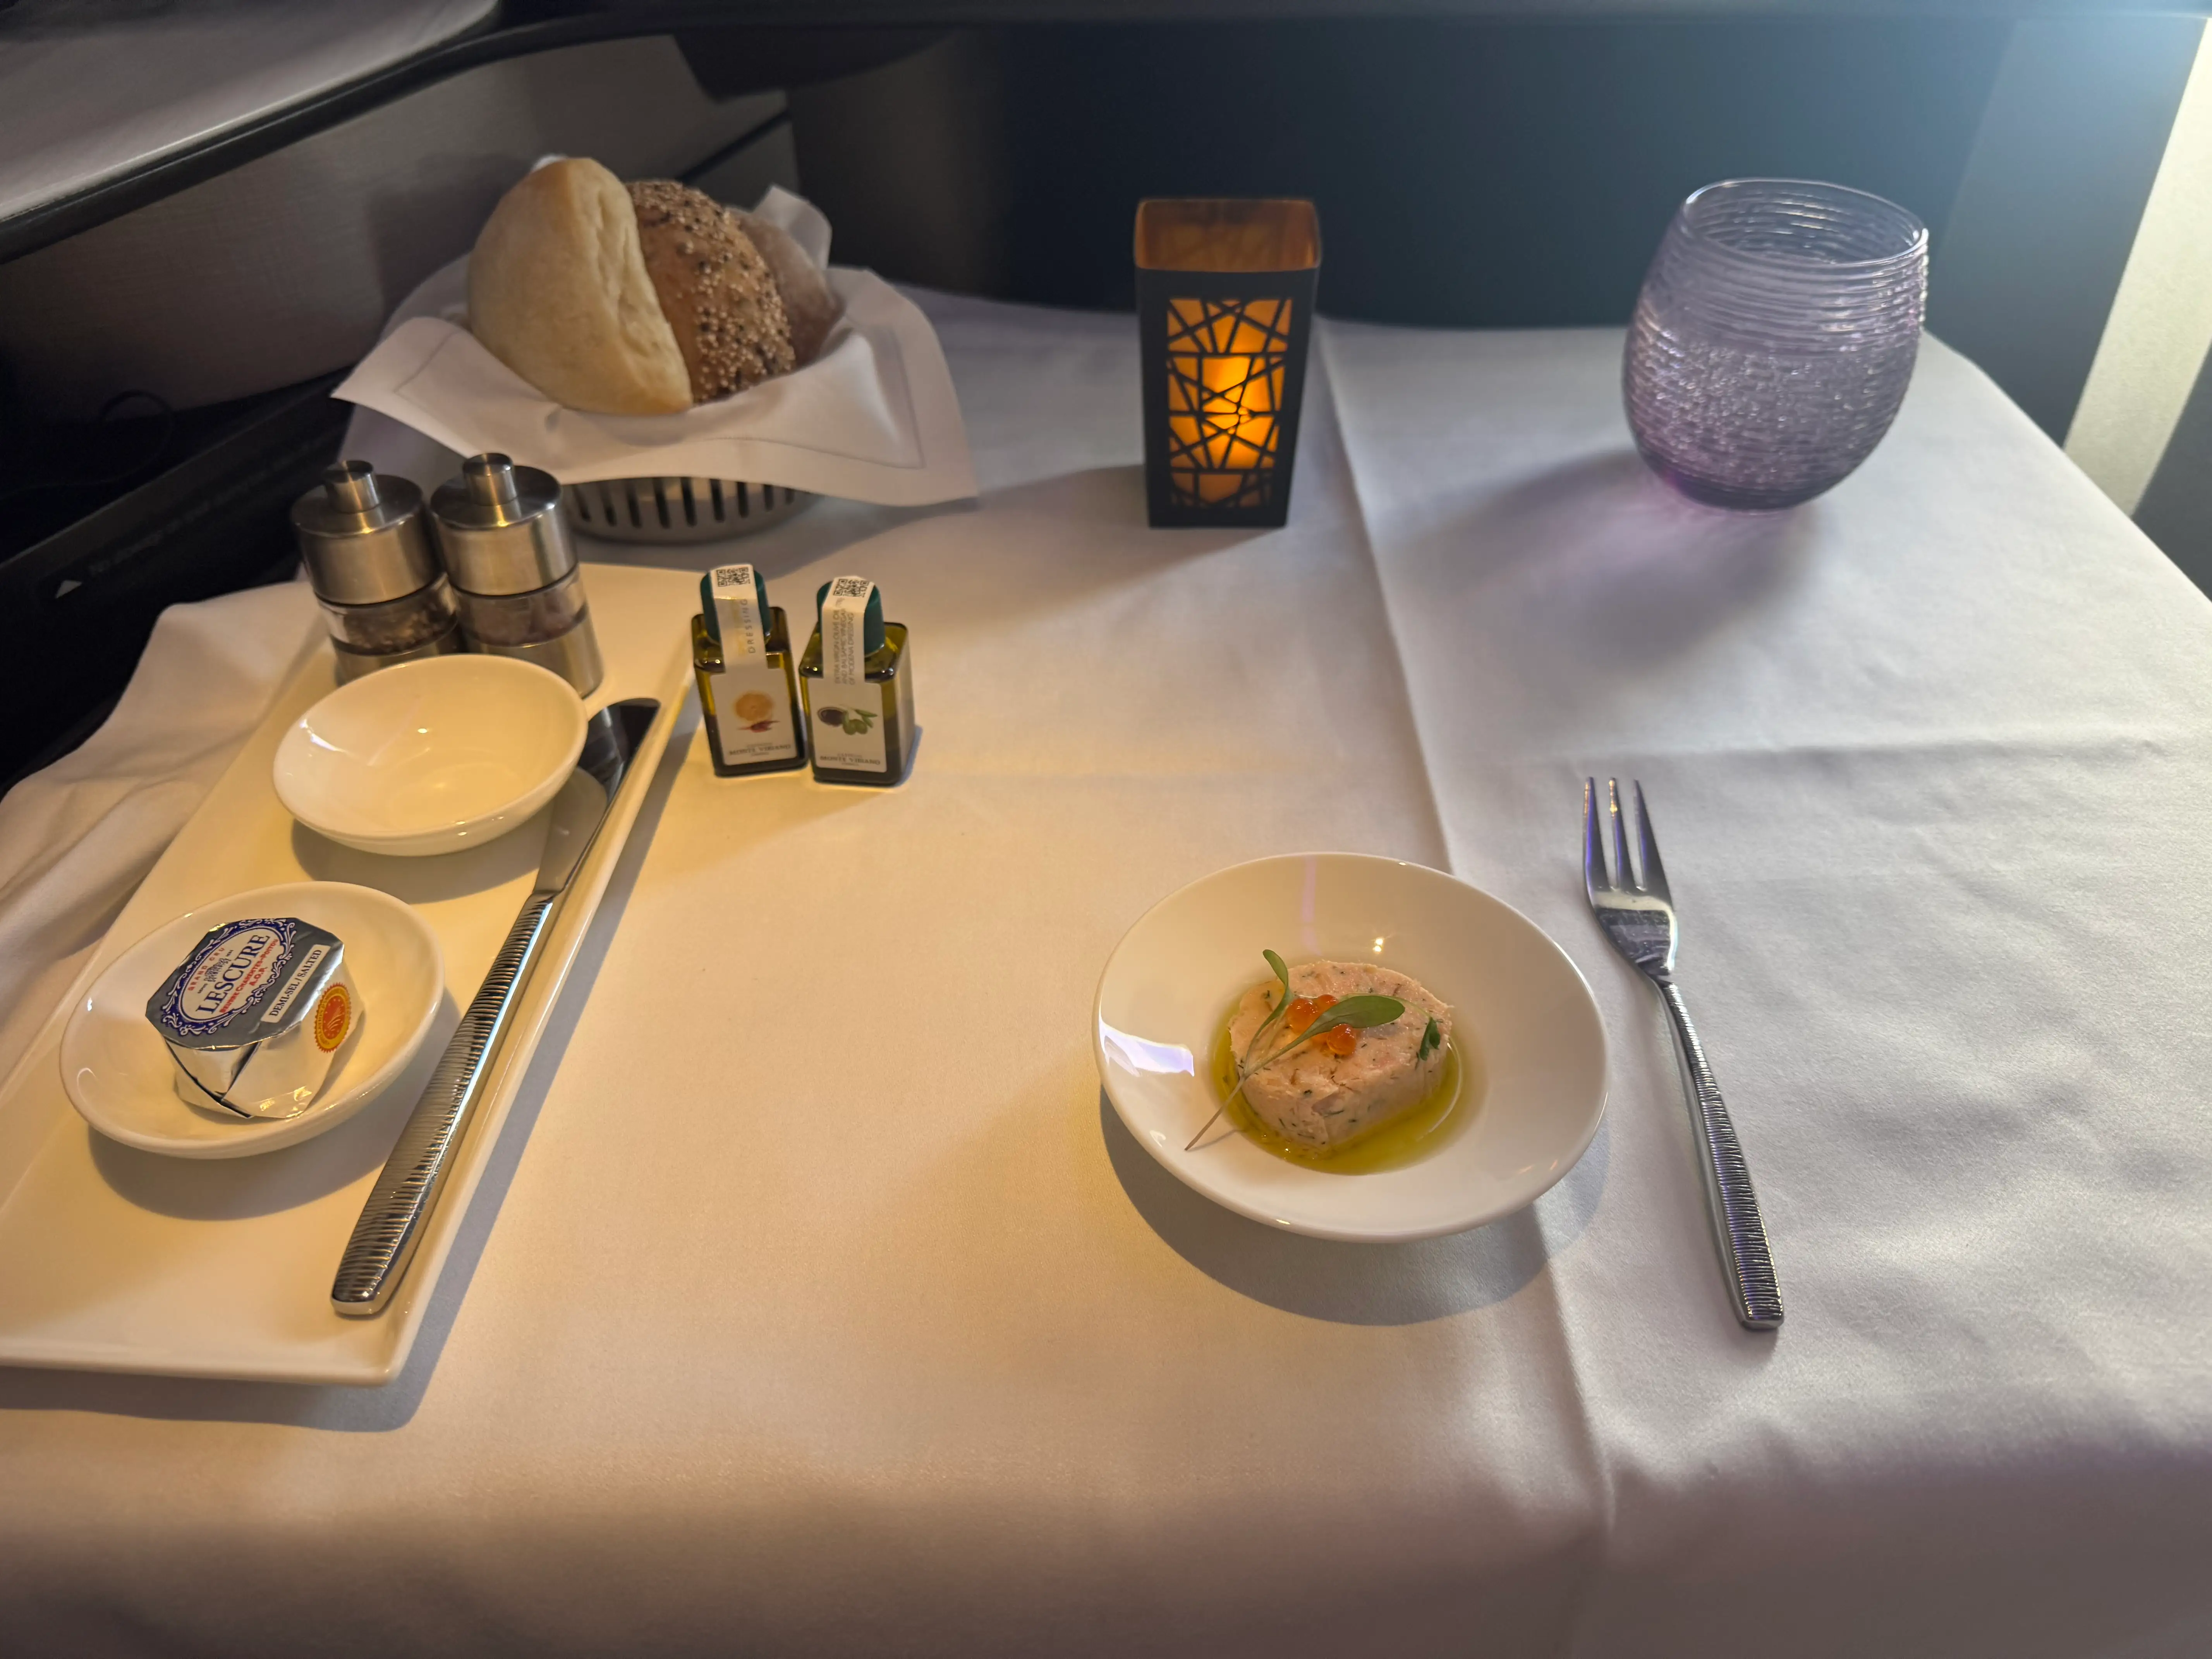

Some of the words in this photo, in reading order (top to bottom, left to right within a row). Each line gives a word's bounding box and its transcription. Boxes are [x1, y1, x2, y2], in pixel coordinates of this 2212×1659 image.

[740, 599, 756, 654] DRESSING
[187, 965, 208, 991] GRAND
[209, 947, 225, 961] CRU
[196, 935, 271, 1014] LESCURE
[219, 992, 240, 1013] BEURRE
[235, 939, 278, 991] CHARENTES-POITOU
[269, 982, 300, 1017] DEMI-SEL
[297, 950, 322, 977] SALTED
